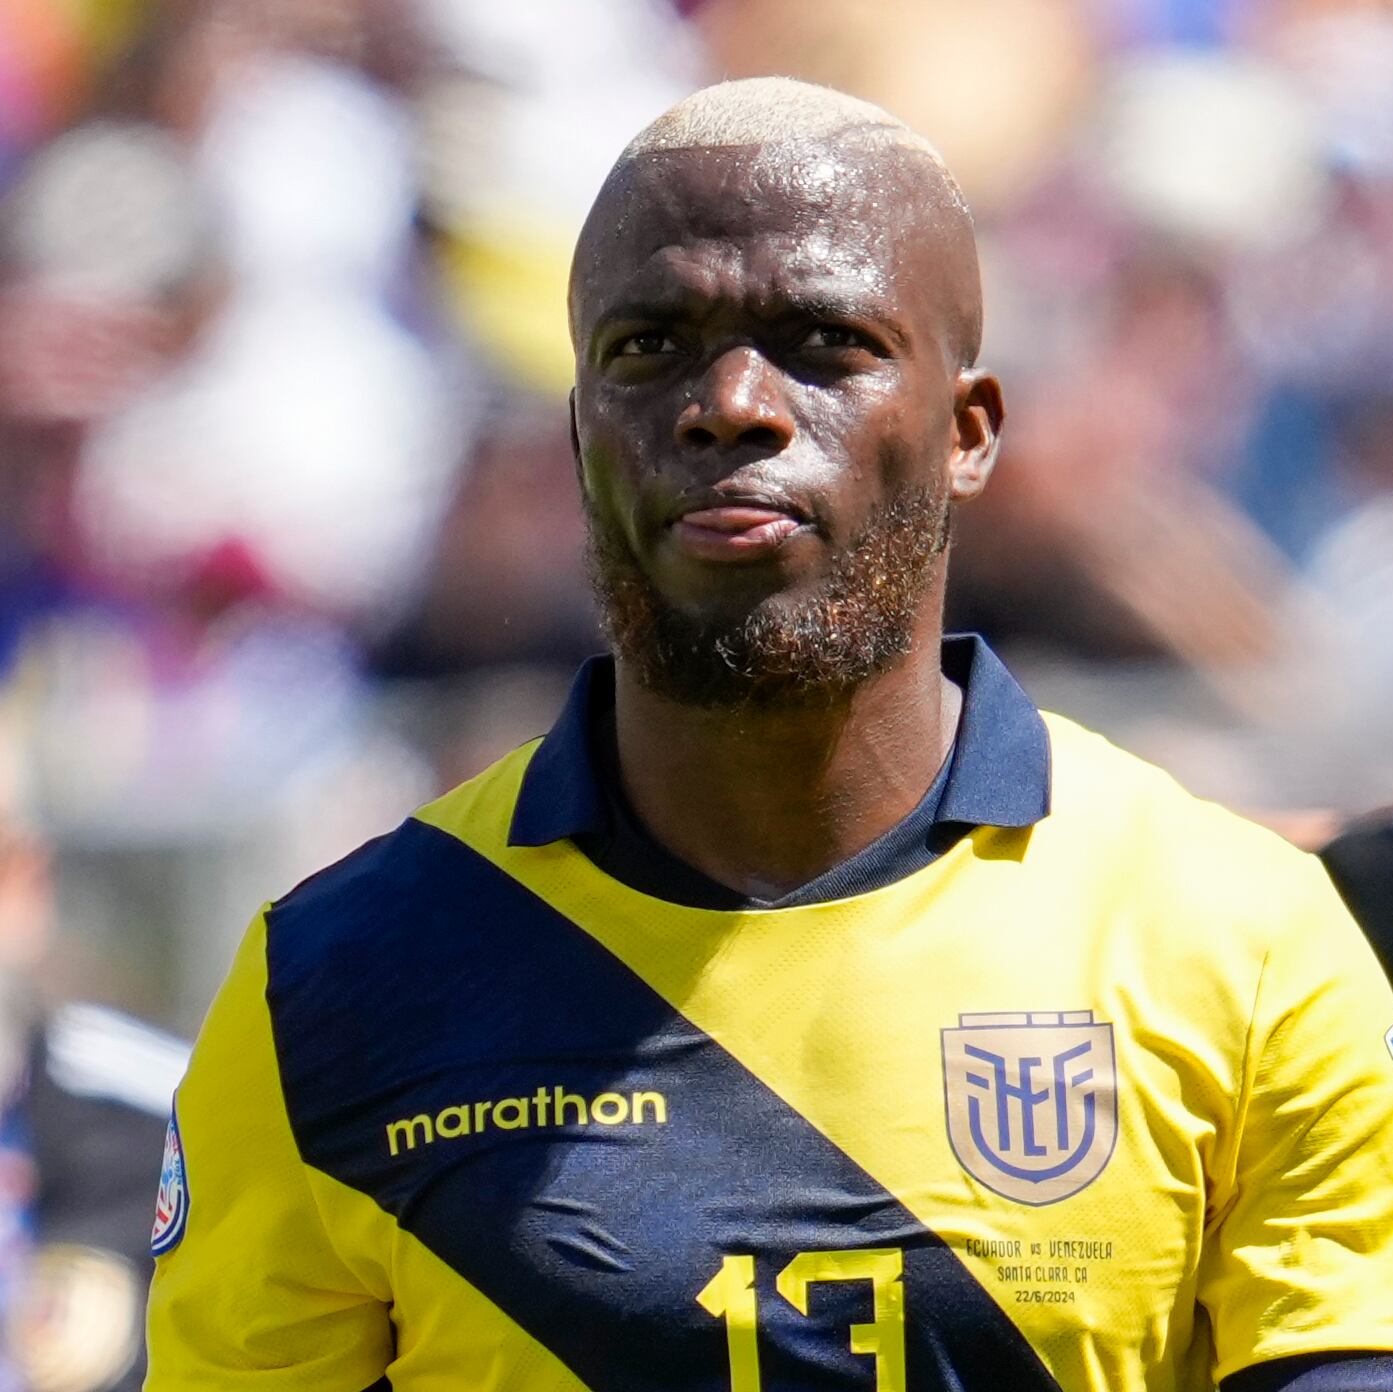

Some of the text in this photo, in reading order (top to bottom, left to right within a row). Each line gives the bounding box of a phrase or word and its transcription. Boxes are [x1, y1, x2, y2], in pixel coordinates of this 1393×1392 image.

[386, 1085, 667, 1156] marathon
[966, 1239, 1022, 1258] ECUADOR
[1049, 1240, 1112, 1260] VENEZUELA
[997, 1265, 1032, 1283] SANTA
[1074, 1266, 1088, 1284] CA
[1014, 1289, 1076, 1304] 22/6/2024
